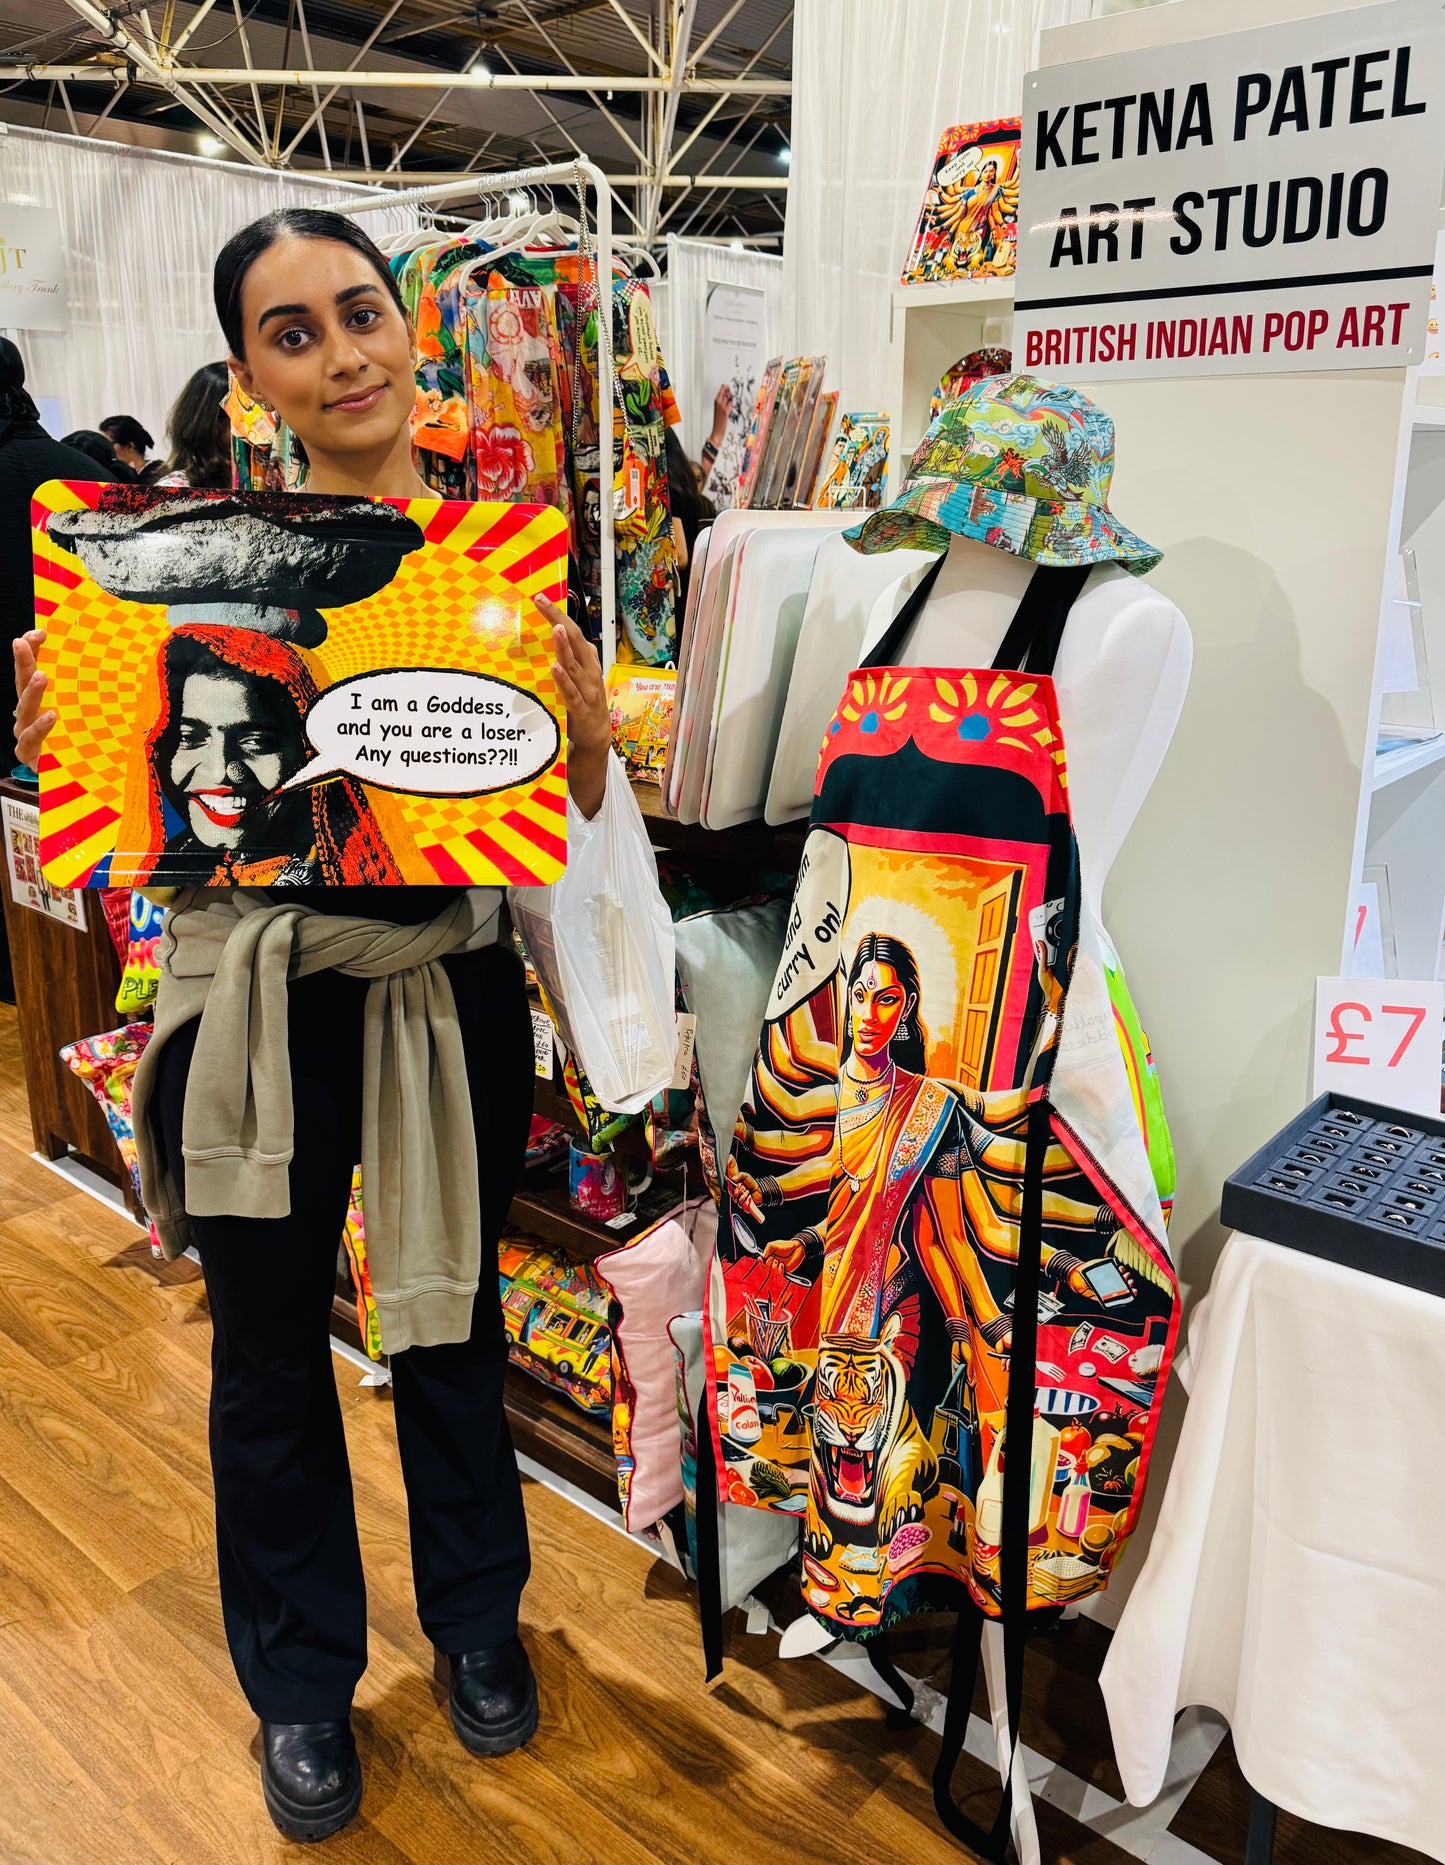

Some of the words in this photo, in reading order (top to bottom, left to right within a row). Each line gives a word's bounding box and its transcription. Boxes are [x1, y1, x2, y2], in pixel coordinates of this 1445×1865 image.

[1035, 82, 1213, 170] KETNA
[1233, 46, 1426, 142] PATEL
[1049, 197, 1155, 268] ART
[1170, 167, 1389, 255] STUDIO
[1025, 323, 1137, 366] BRITISH
[1146, 314, 1253, 359] INDIAN
[1263, 309, 1328, 353] POP
[1336, 302, 1410, 348] ART
[350, 693, 361, 709] I
[371, 697, 398, 712] am
[407, 701, 418, 712] a
[426, 696, 510, 718] Goddess,
[337, 719, 371, 736] and
[380, 724, 412, 741] you
[421, 726, 452, 739] are
[461, 728, 472, 739] a
[481, 723, 532, 742] loser.
[355, 745, 391, 766] Any
[400, 748, 518, 767] questions??!!
[7, 804, 24, 821] THE
[777, 943, 815, 1000] curry
[815, 901, 841, 943] on!
[122, 977, 158, 1000] PLE
[1326, 1002, 1426, 1067] £7
